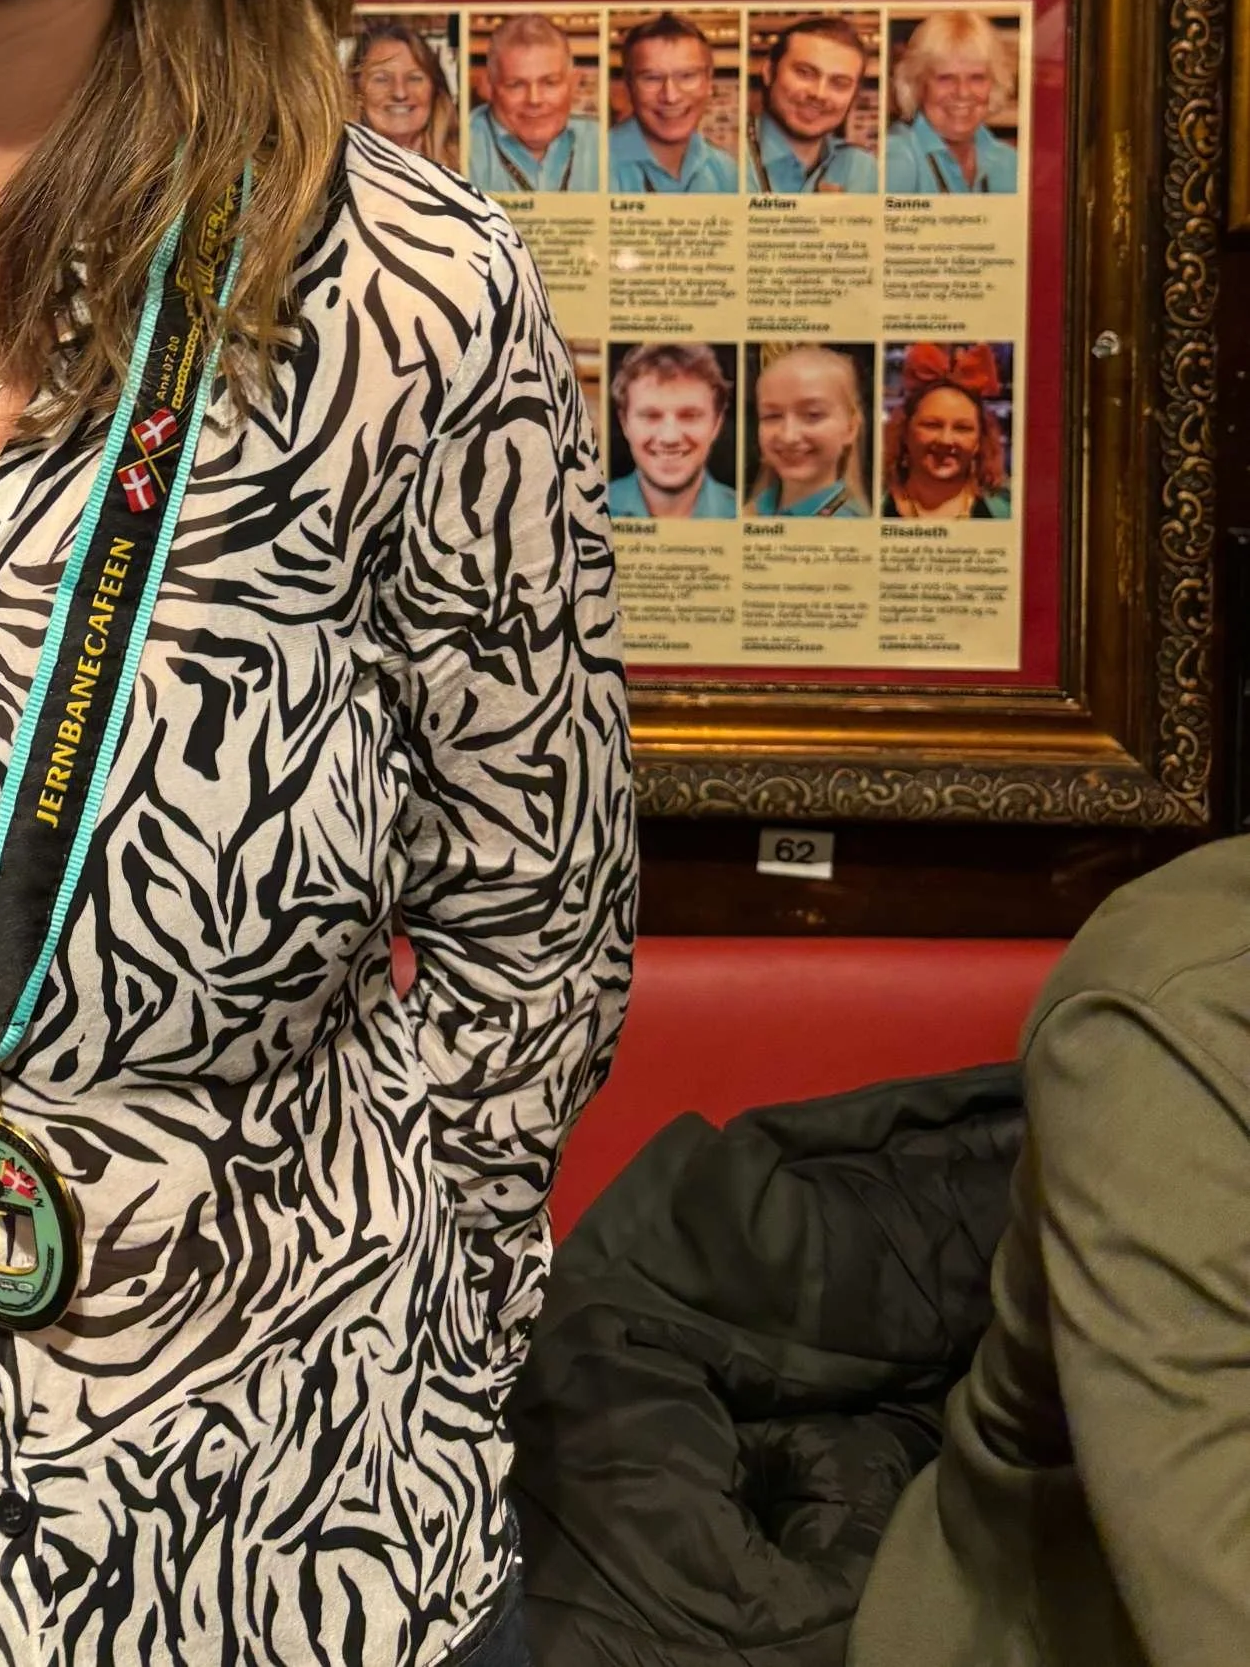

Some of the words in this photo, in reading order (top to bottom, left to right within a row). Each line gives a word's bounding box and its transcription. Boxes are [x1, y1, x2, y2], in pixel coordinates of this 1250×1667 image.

[609, 199, 646, 212] Lars
[748, 197, 797, 210] Adrian
[743, 523, 785, 535] Randi
[880, 525, 948, 538] Elisabeth
[36, 536, 136, 829] JERNBANECAFEEN
[775, 837, 815, 863] 62
